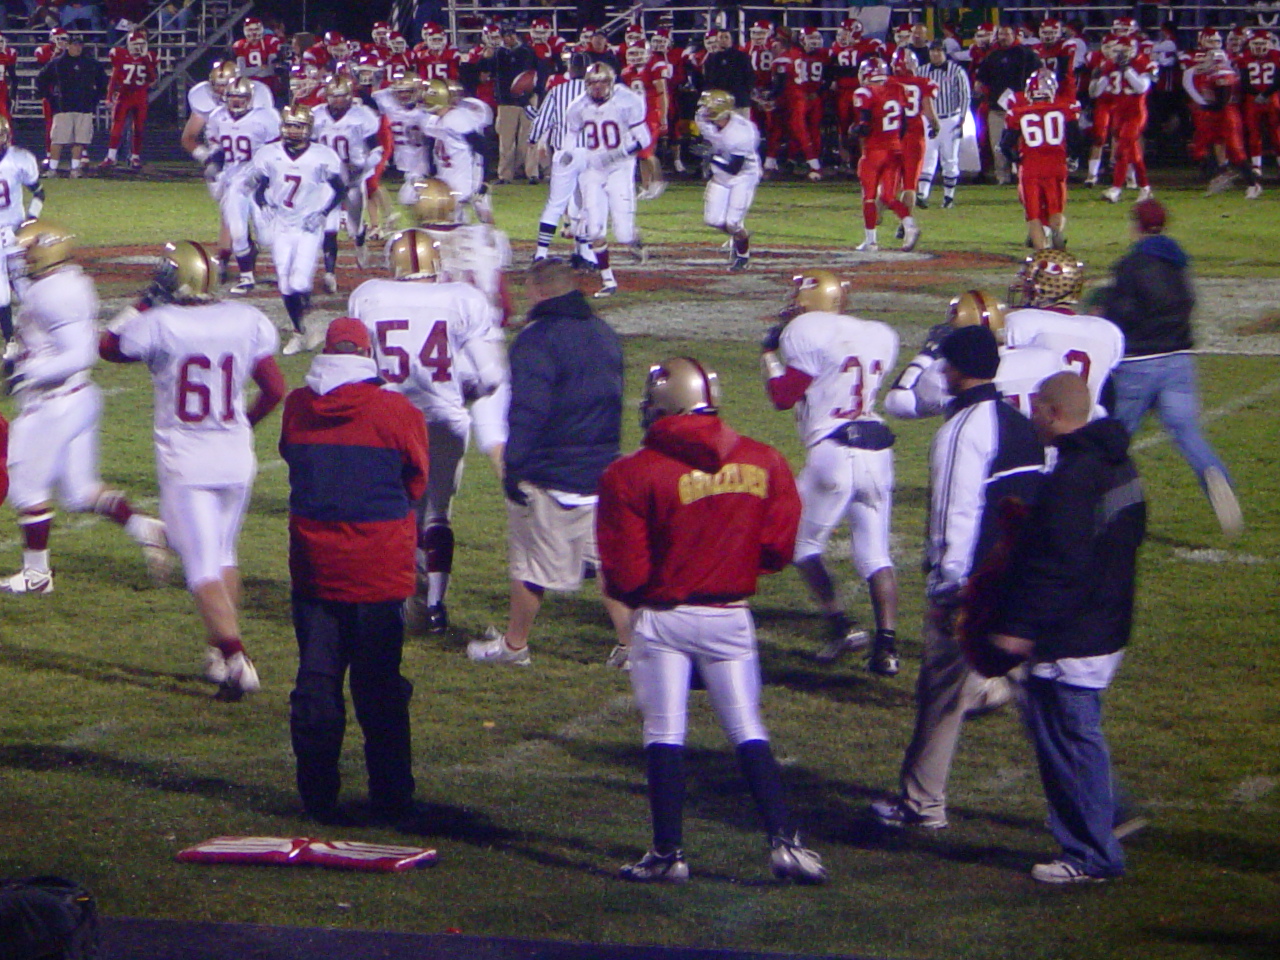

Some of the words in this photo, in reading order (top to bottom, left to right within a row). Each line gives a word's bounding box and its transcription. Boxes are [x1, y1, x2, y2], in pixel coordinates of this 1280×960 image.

[122, 64, 147, 86] 75
[1247, 62, 1275, 85] 22
[1020, 110, 1066, 148] 60
[282, 173, 302, 209] 7
[375, 319, 453, 383] 54
[178, 352, 235, 423] 61
